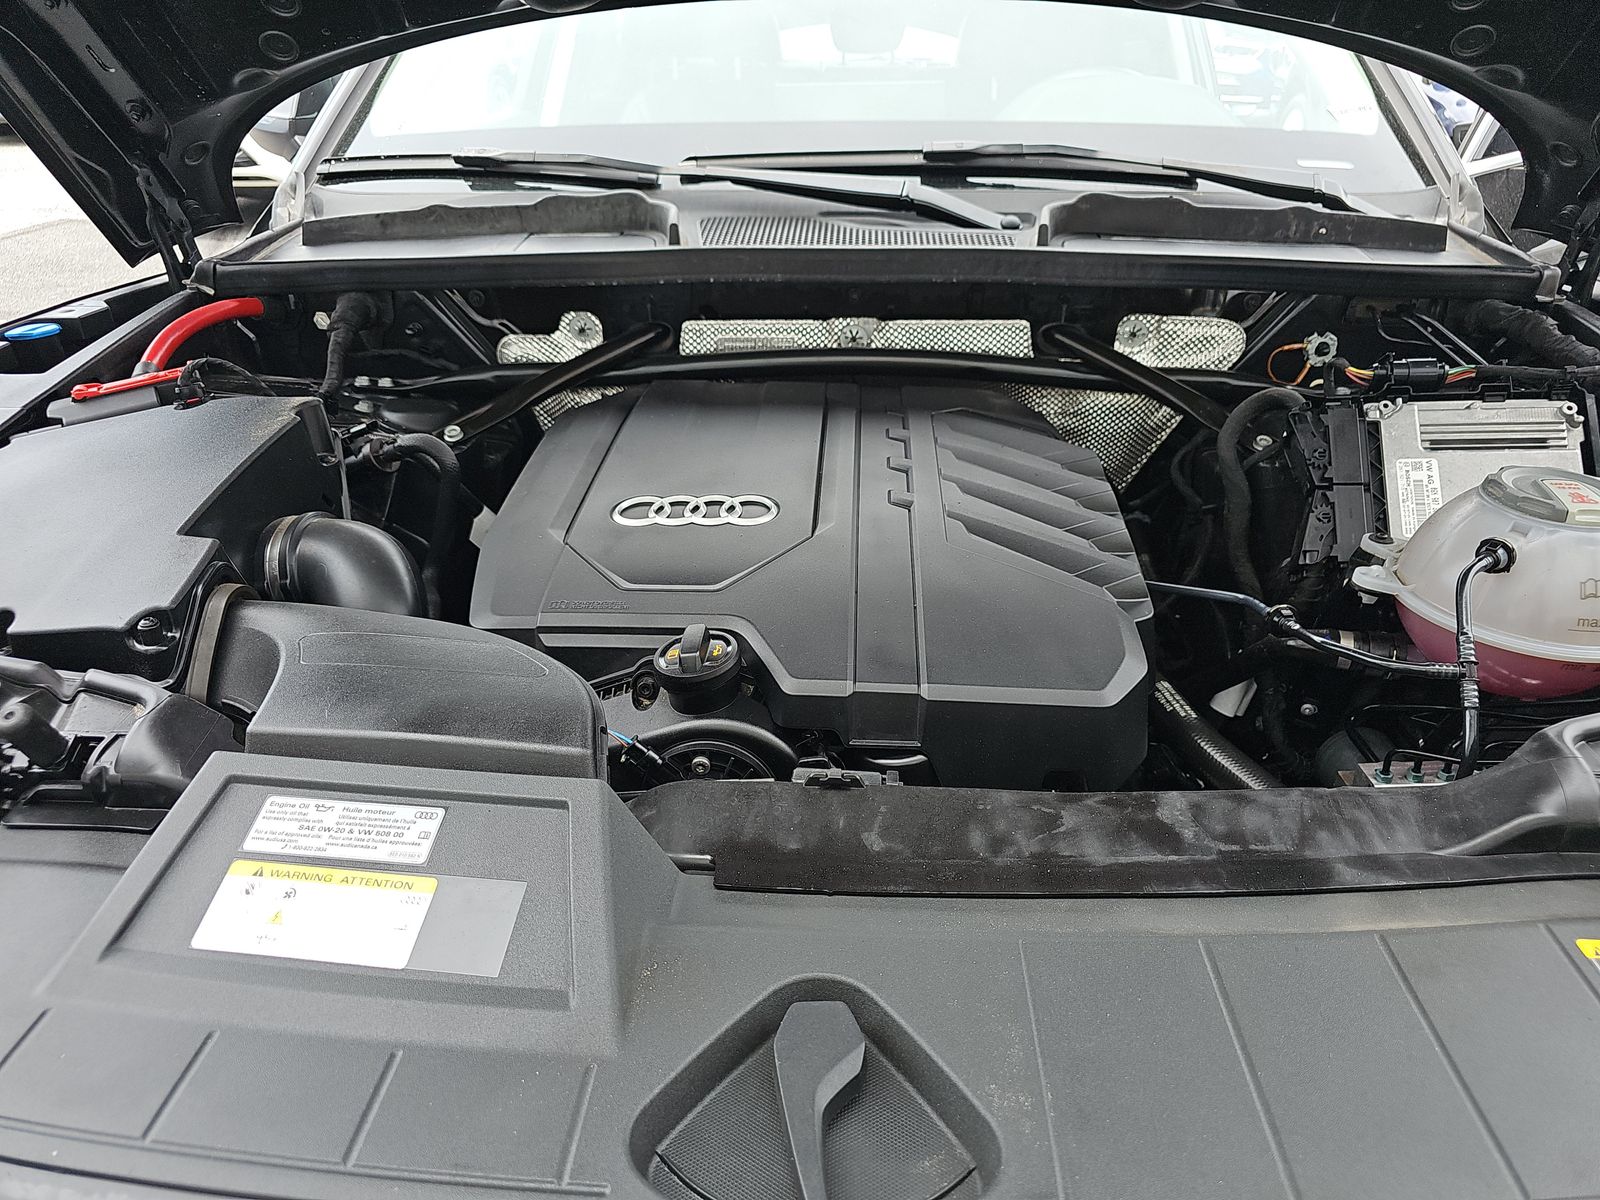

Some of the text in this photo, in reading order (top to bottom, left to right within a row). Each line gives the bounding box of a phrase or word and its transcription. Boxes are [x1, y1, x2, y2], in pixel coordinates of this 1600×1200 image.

[1425, 460, 1433, 473] VW
[1427, 474, 1434, 485] AG
[269, 801, 296, 809] Engine
[342, 806, 396, 816] Huile moteur
[297, 824, 316, 832] SAE
[317, 825, 346, 834] 0W-20
[358, 828, 374, 836] VW
[269, 869, 414, 890] WARNING ATTENTION
